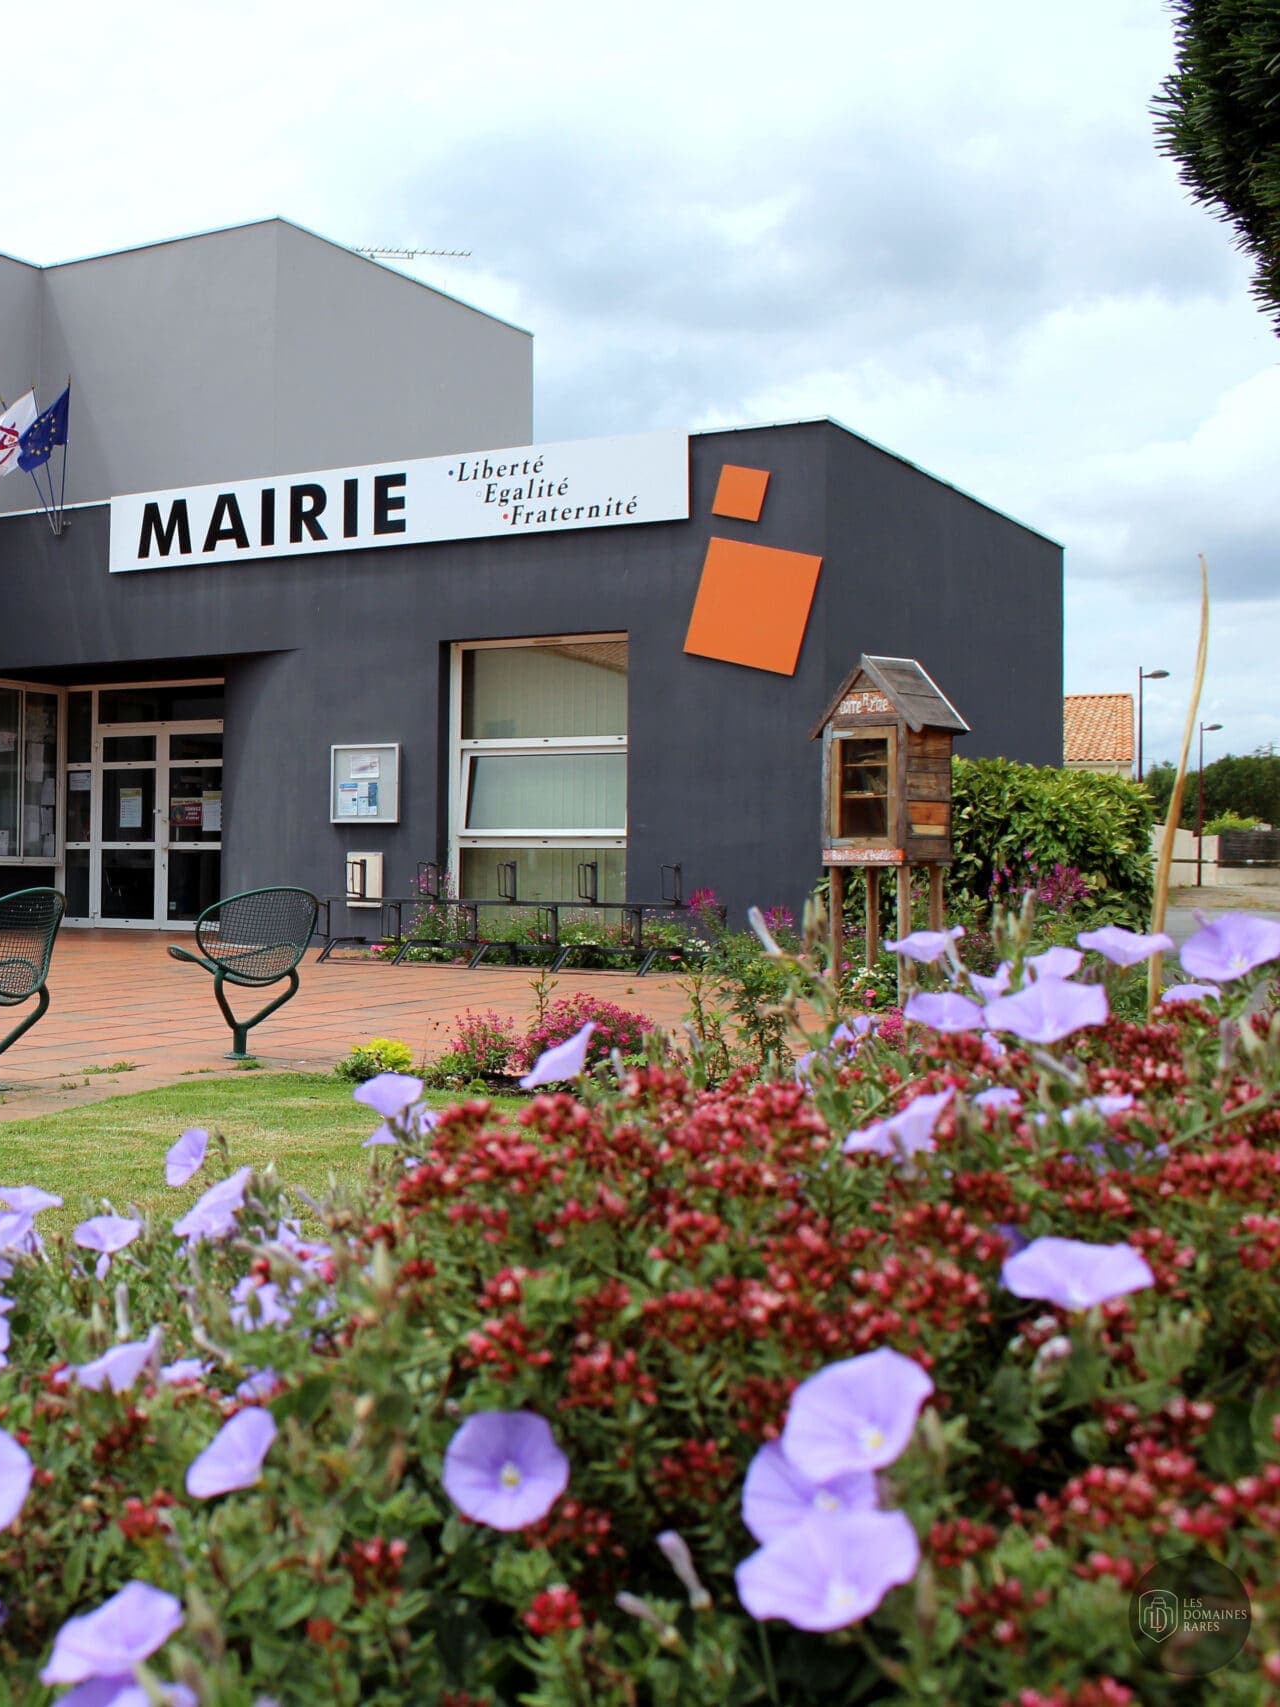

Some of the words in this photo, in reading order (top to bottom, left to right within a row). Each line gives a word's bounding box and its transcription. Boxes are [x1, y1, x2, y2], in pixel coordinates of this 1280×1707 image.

[457, 455, 545, 482] Liberté
[484, 477, 569, 507] Egalité
[137, 472, 408, 559] MAIRIE
[510, 495, 638, 526] Fraternité
